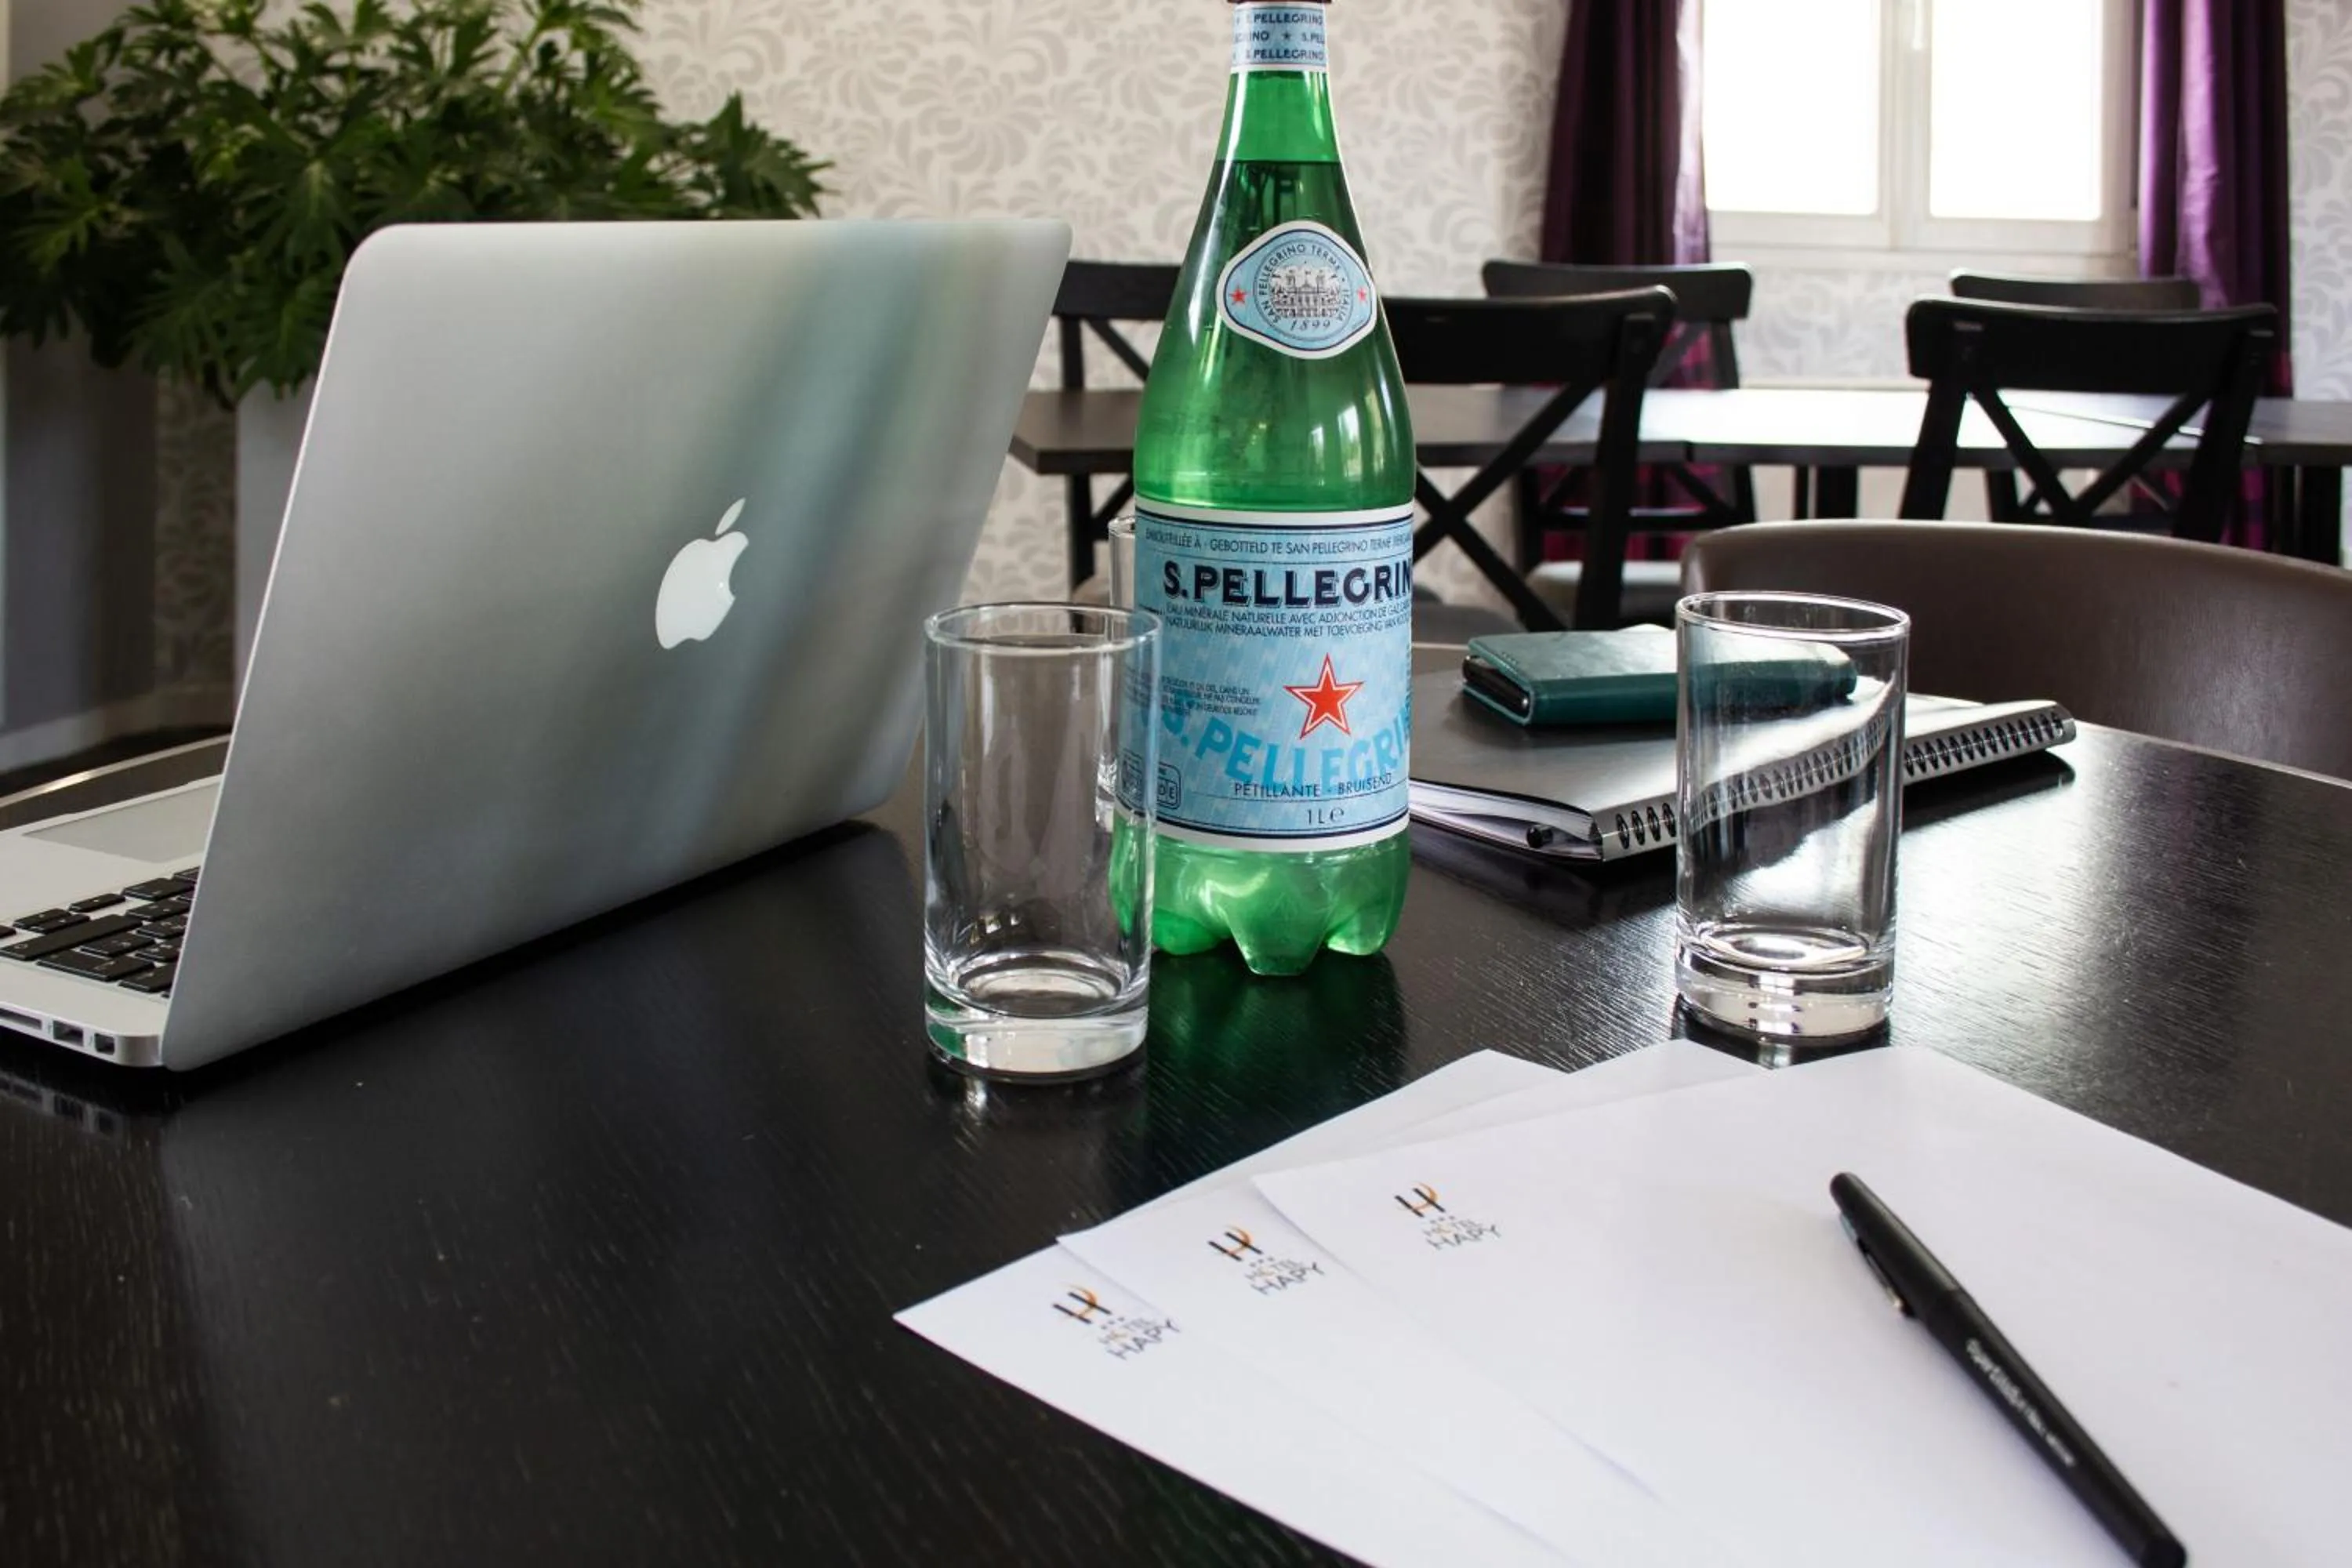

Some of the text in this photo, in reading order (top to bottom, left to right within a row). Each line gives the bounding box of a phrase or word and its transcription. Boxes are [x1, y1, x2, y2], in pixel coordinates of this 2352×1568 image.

[1210, 539, 1268, 554] GEBOTTELD
[1272, 543, 1283, 554] TE
[1286, 542, 1310, 554] SAN
[1312, 539, 1368, 554] PELLEGRINO
[1231, 611, 1287, 625] NATURELLE
[1289, 614, 1316, 625] AVEC
[1319, 608, 1377, 624] ADJONCTION
[1215, 622, 1301, 637] MINERAALWATER
[1304, 626, 1323, 637] MET
[1338, 772, 1392, 795] BRUISEND
